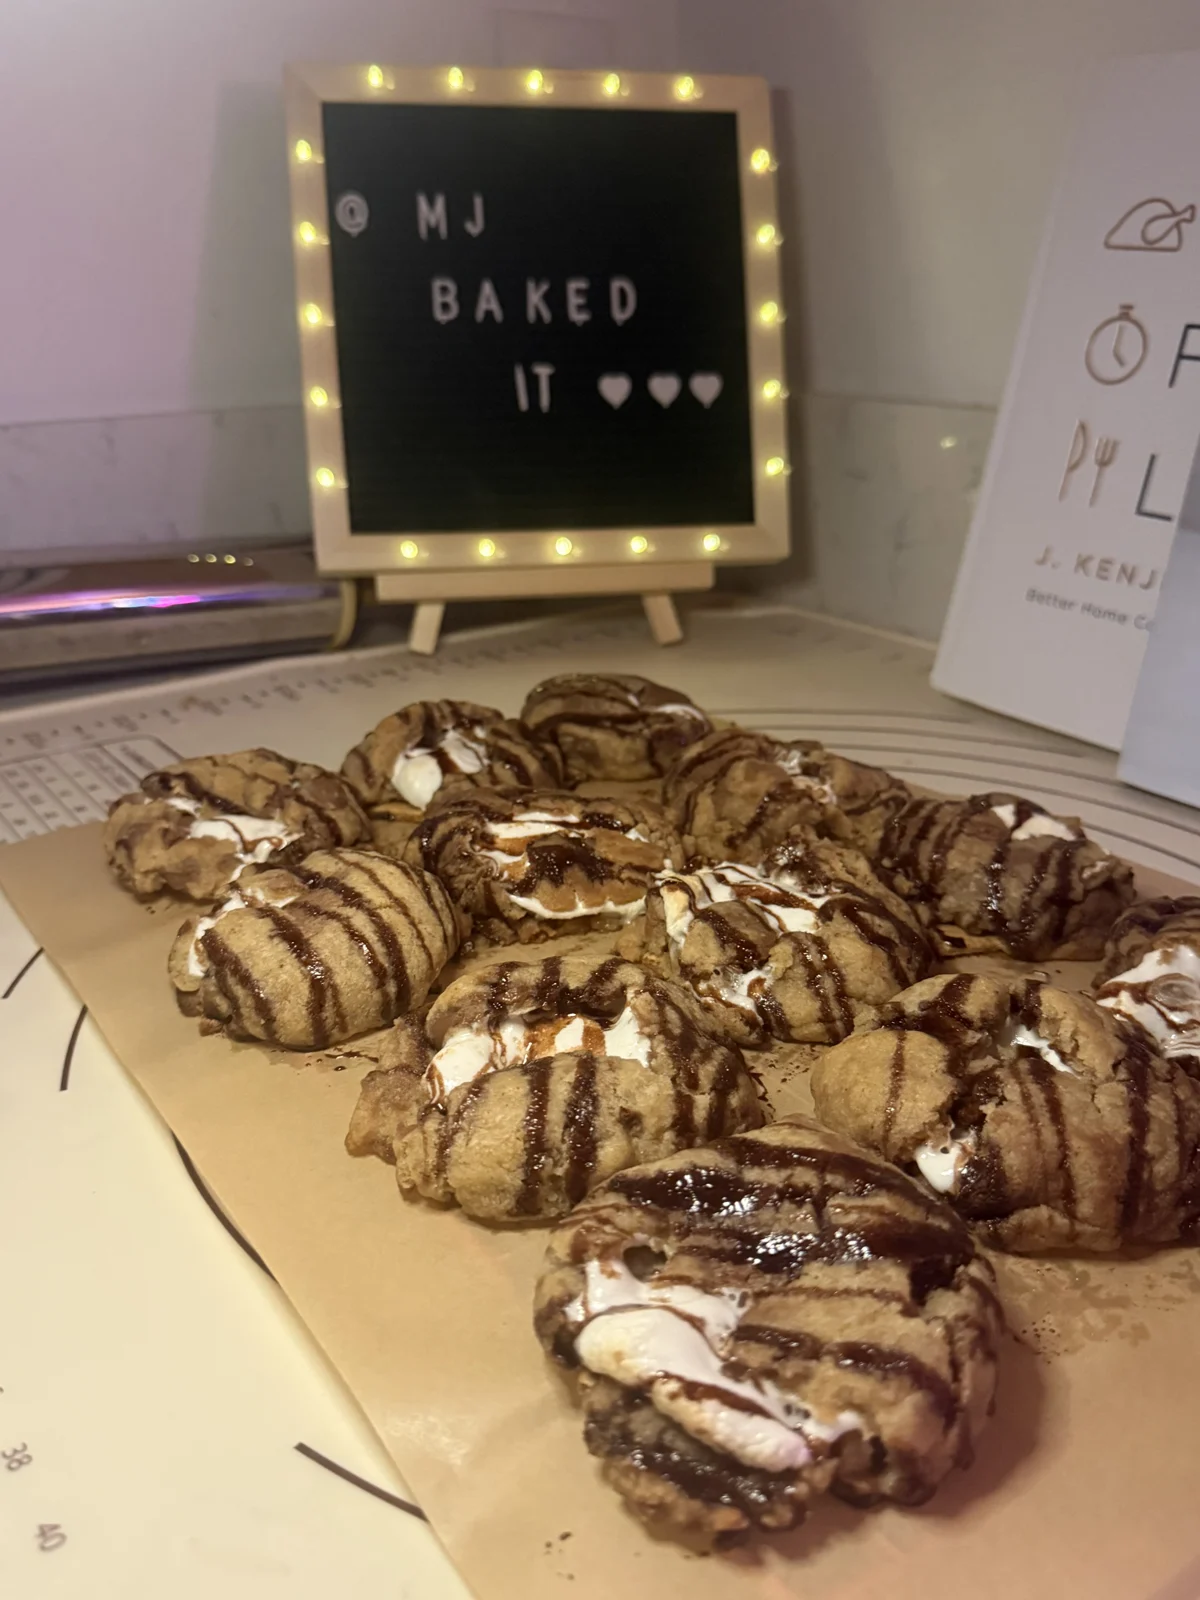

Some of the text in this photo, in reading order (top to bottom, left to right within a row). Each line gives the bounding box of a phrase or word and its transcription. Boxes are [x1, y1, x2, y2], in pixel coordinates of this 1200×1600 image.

[416, 191, 485, 241] MJ
[431, 276, 638, 326] BAKED
[514, 363, 555, 413] IT
[1025, 586, 1075, 611] Better
[1079, 601, 1128, 625] Home
